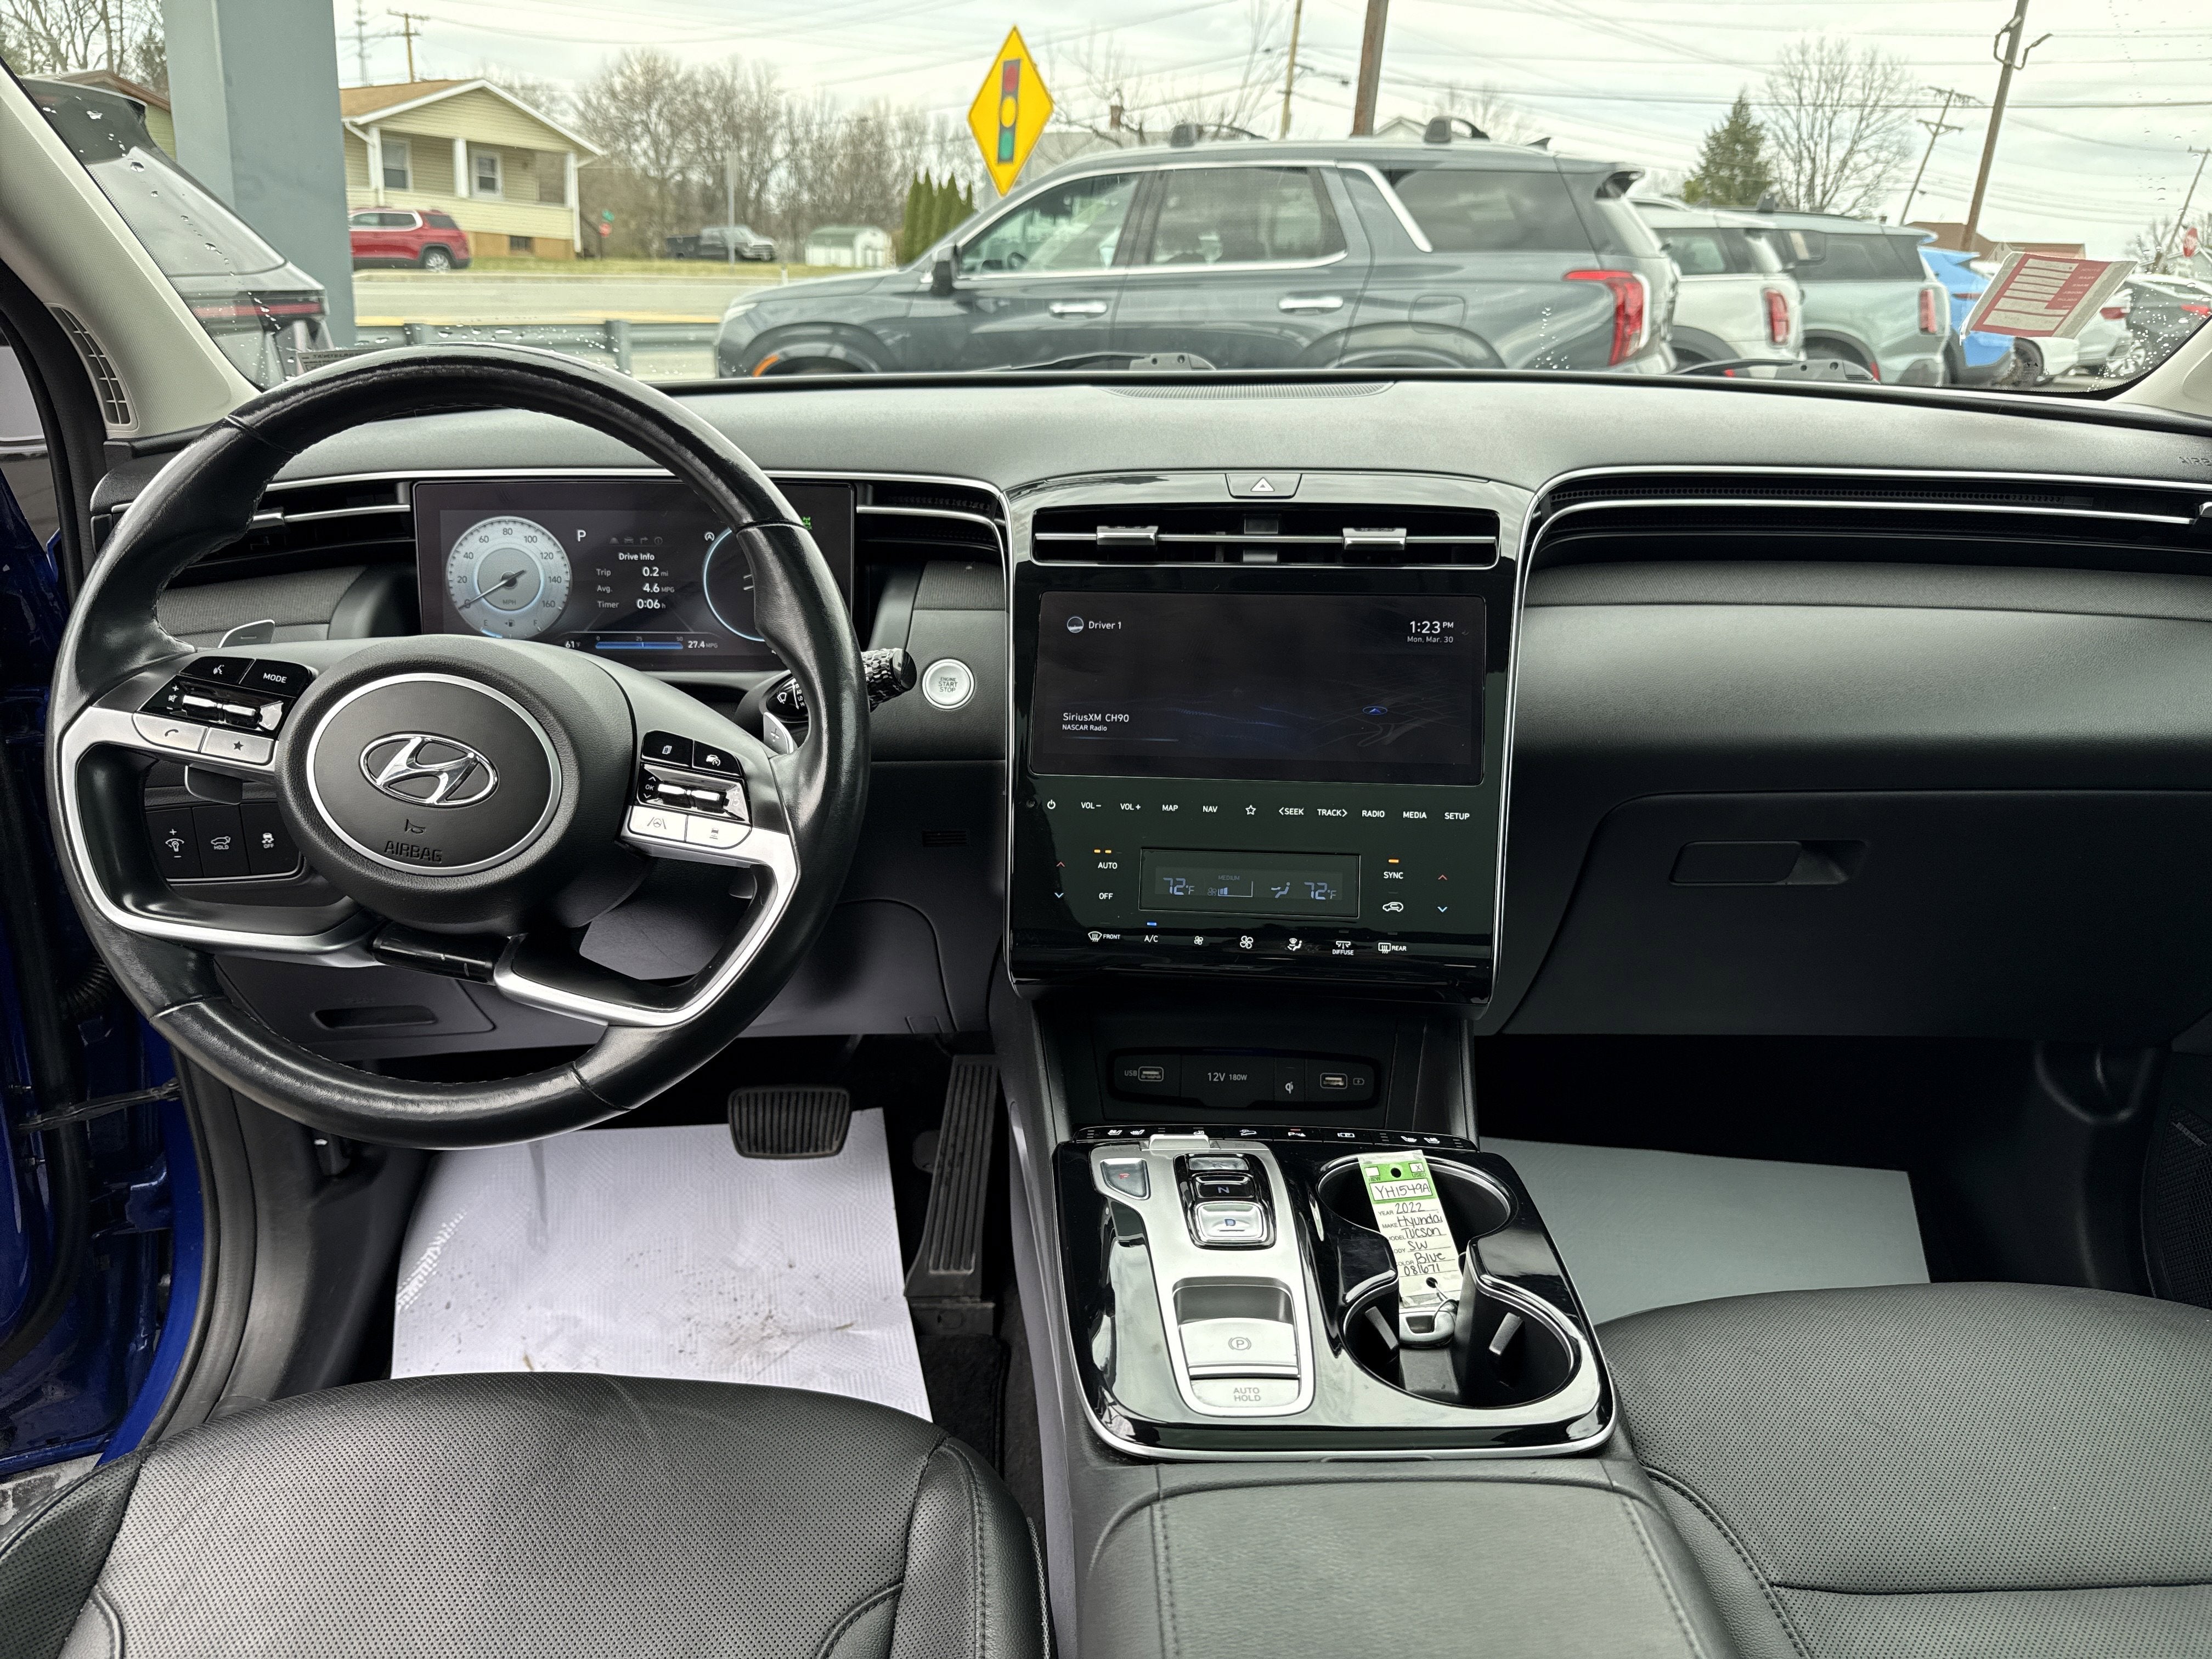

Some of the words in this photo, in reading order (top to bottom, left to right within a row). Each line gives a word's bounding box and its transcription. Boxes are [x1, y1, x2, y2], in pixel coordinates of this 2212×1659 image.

[577, 529, 586, 542] P
[618, 552, 639, 561] Drive
[596, 568, 611, 577] Trip
[642, 567, 659, 577] 0.2
[597, 585, 613, 594] Avg.
[642, 583, 660, 593] 4.6
[636, 599, 661, 609] 0:06
[1088, 621, 1115, 629] Driver
[1118, 621, 1121, 629] 1
[1410, 620, 1440, 634] 1:23
[263, 673, 287, 684] MODE
[1063, 713, 1101, 721] SiriusXM
[1105, 714, 1129, 722] CH90
[1362, 810, 1385, 818] RADIO
[1403, 811, 1427, 819] MEDIA
[384, 840, 443, 862] AIRBAG
[1207, 1072, 1226, 1081] 12V
[1375, 1183, 1430, 1199] YH1549A
[1395, 1202, 1425, 1214] 2022
[1397, 1211, 1443, 1229] Hyundai
